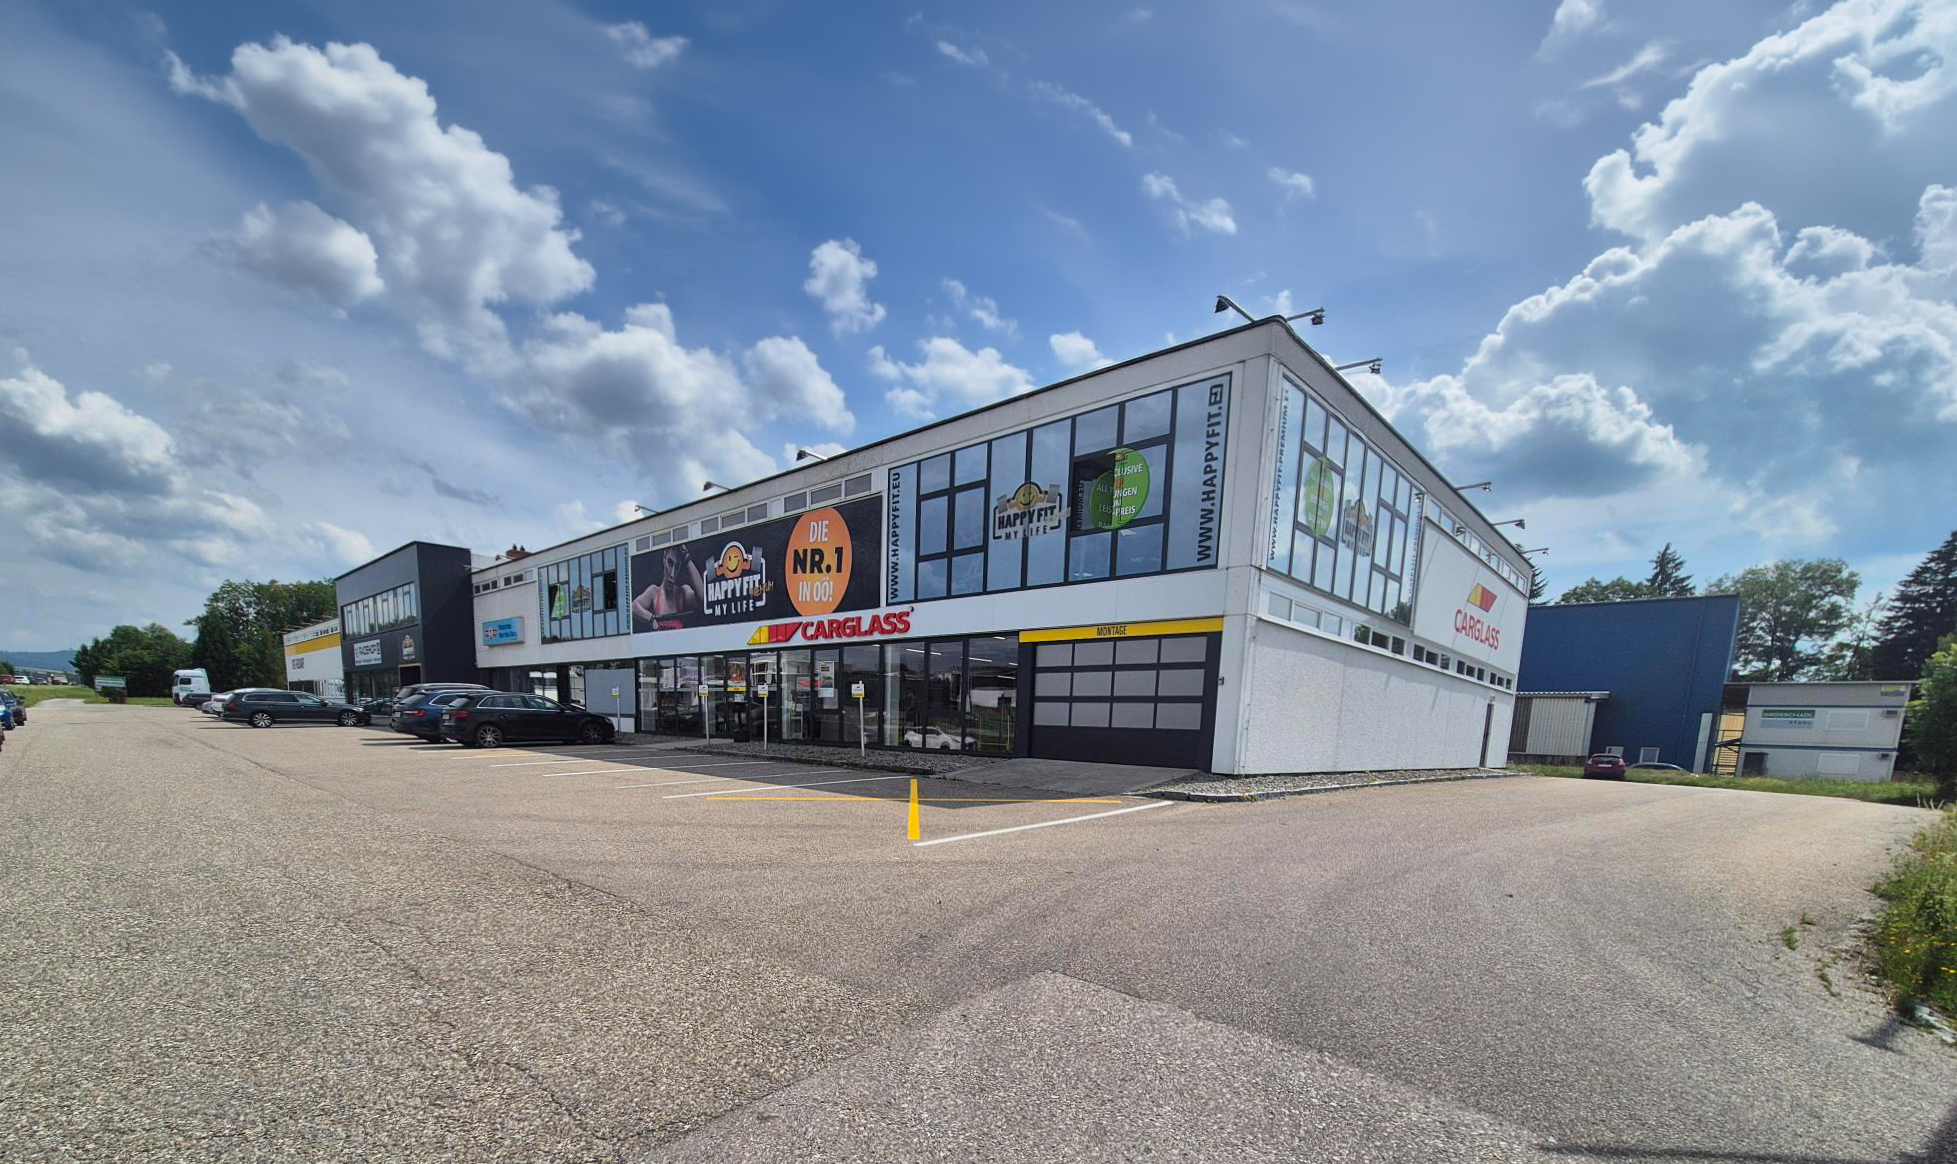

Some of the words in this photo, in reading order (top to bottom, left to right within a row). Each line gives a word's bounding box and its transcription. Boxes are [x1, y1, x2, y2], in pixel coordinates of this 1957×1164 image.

[809, 520, 829, 543] DIE
[890, 472, 901, 600] WWW.HAPPYFIT.EU
[1004, 530, 1019, 541] MY
[1023, 525, 1048, 538] LIFE
[798, 581, 811, 602] IN
[813, 576, 834, 603] OÖ!
[714, 603, 728, 617] MY
[731, 599, 755, 614] LIFE
[800, 610, 911, 641] CARGLASS
[1096, 625, 1127, 637] MONTAGE
[1454, 608, 1501, 651] CARGLASS
